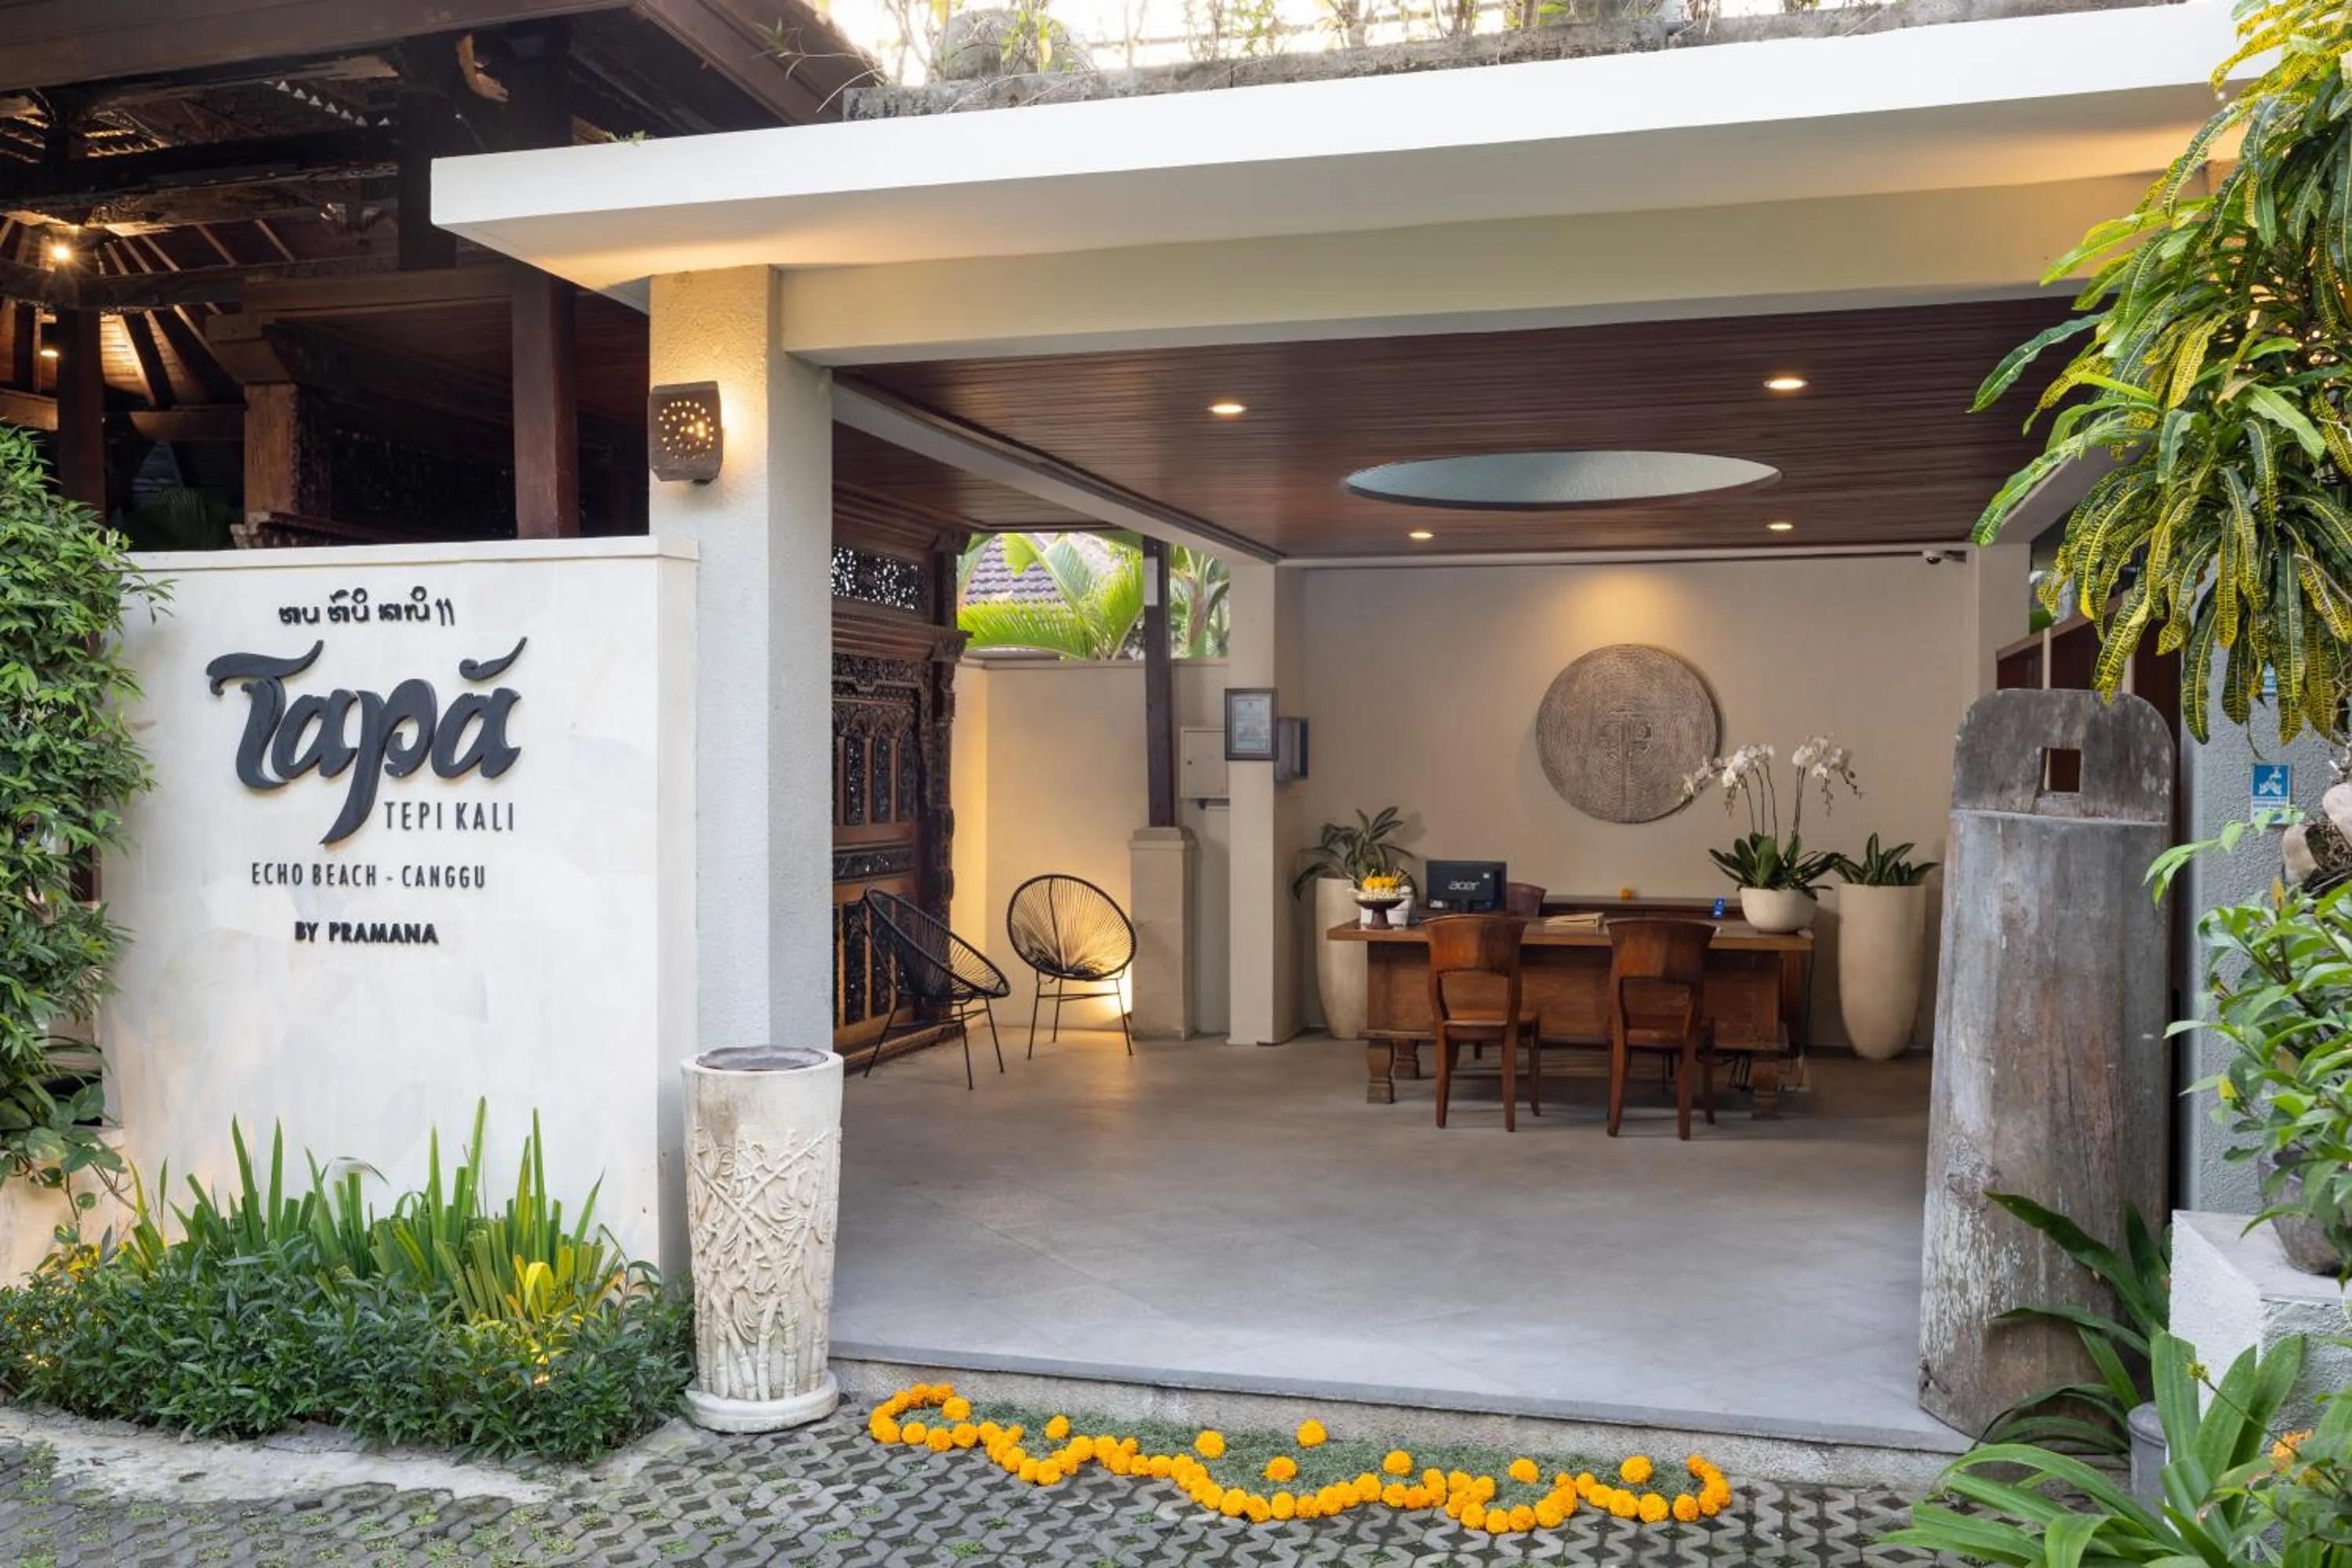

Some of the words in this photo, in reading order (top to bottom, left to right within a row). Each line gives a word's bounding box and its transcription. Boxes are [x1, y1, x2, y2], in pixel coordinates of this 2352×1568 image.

[384, 801, 442, 831] TEPI
[456, 801, 514, 832] KALI
[252, 862, 303, 886] ECHO
[312, 863, 377, 887] BEACH
[401, 865, 485, 889] CANGGU
[1447, 880, 1480, 891] acer
[294, 920, 319, 943] BY
[328, 920, 440, 946] PRAMANA
